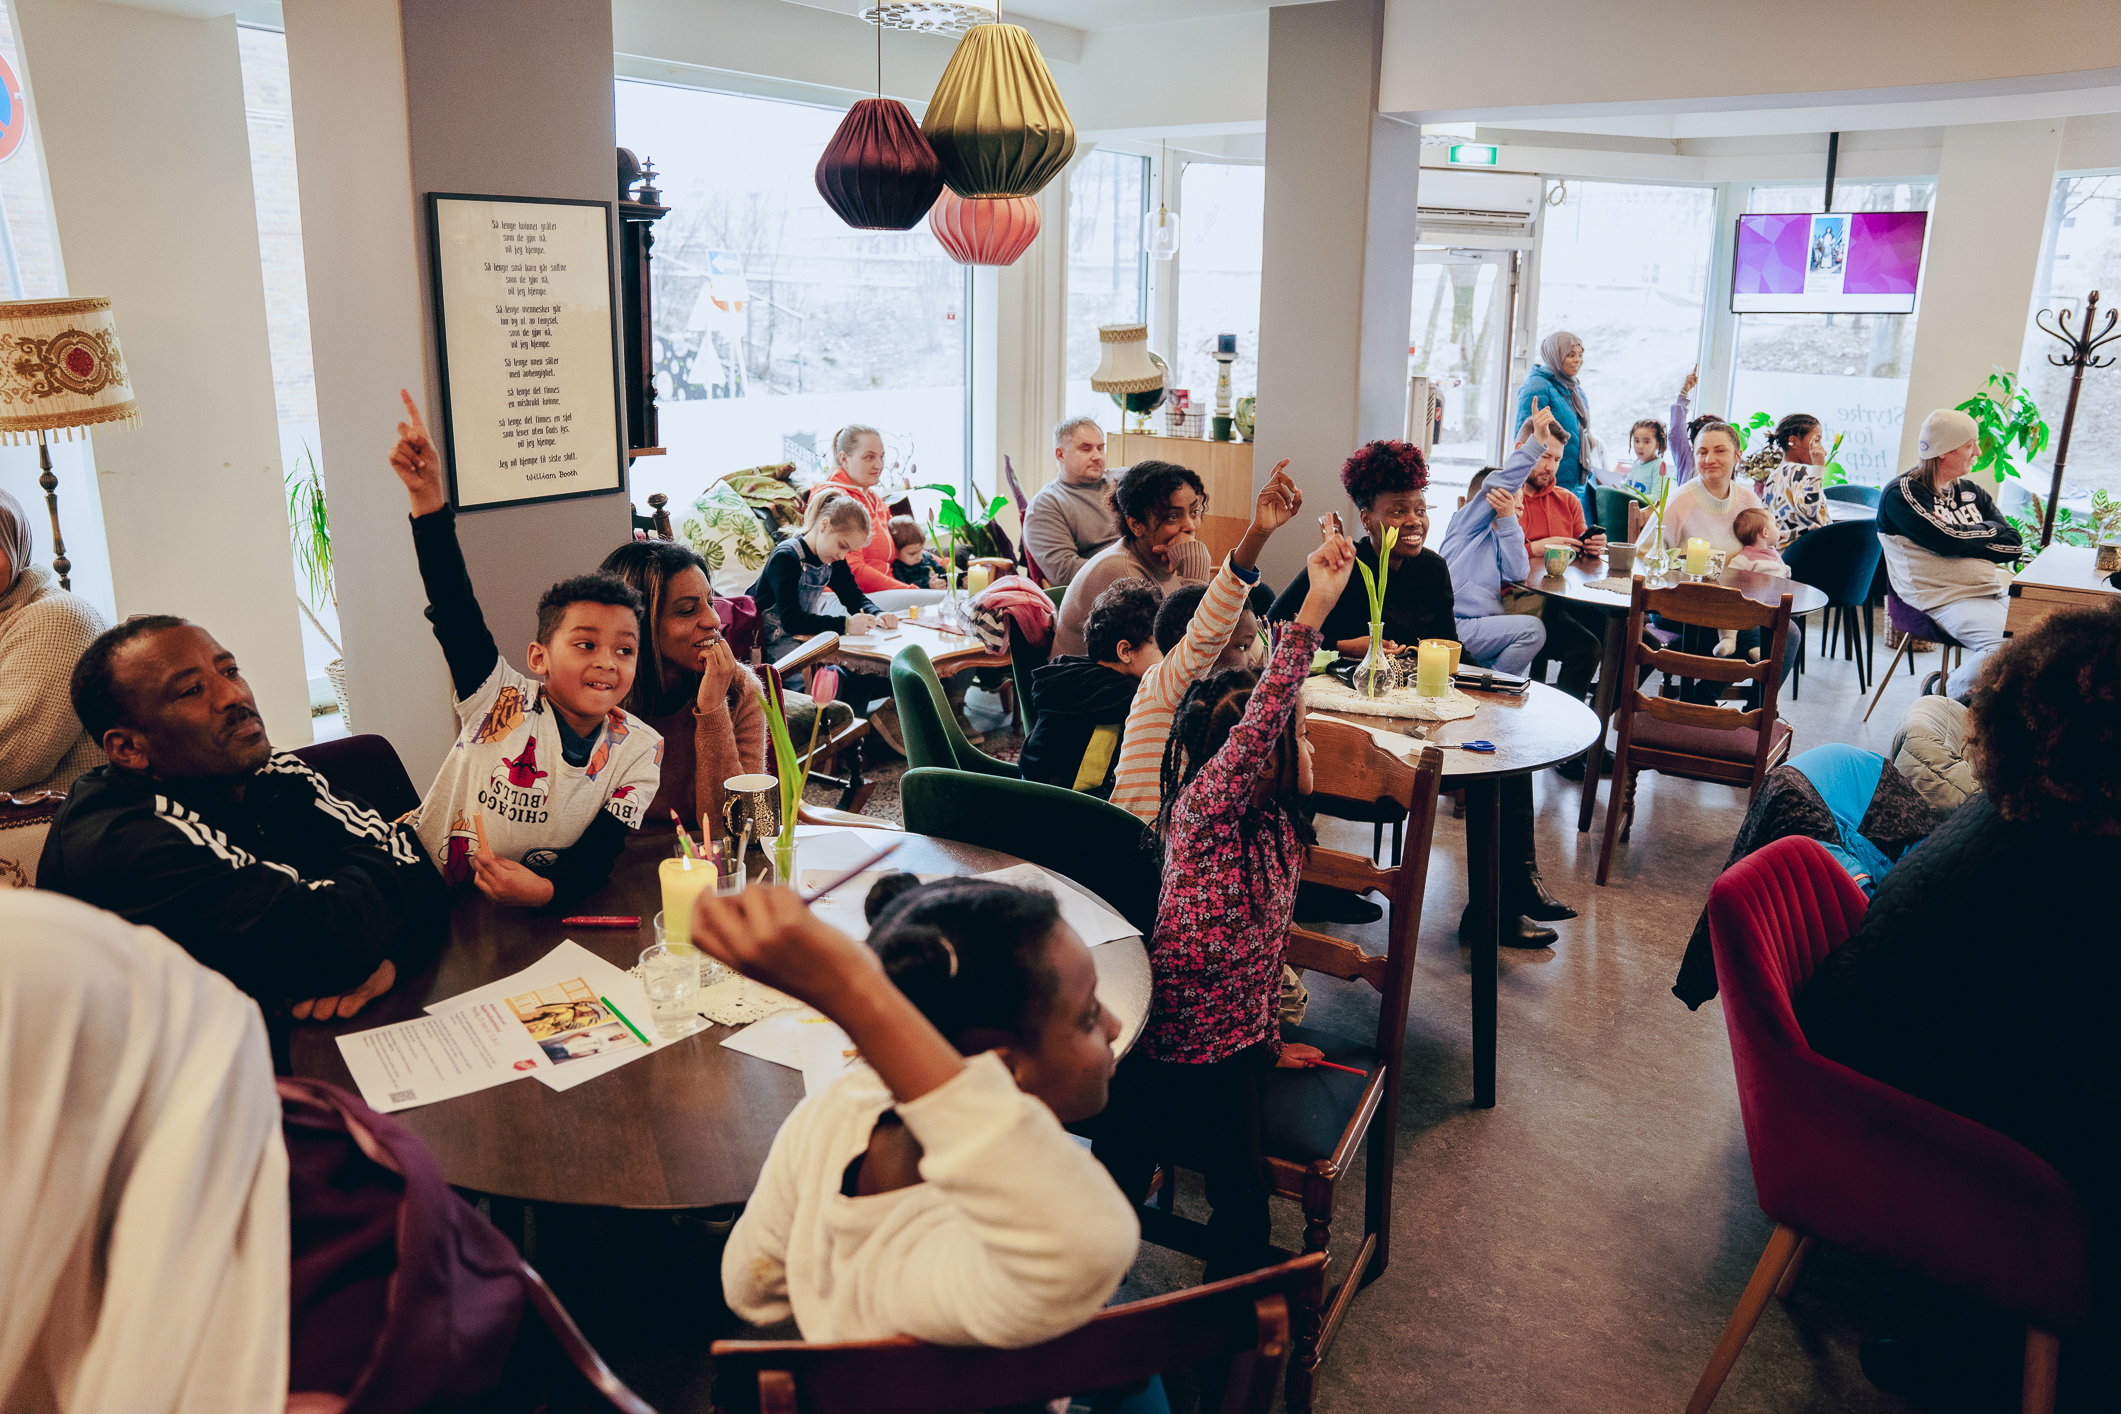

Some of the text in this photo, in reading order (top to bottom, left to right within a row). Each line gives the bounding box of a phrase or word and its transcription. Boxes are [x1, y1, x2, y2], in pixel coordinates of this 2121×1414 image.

[501, 220, 516, 232] lenge
[514, 245, 523, 255] jeg
[494, 263, 508, 273] lenge
[517, 287, 526, 297] jeg
[505, 305, 519, 315] lenge
[520, 340, 529, 350] jeg
[513, 358, 528, 368] lenge
[516, 387, 530, 397] lenge
[507, 418, 522, 427] lenge
[526, 439, 535, 449] jeg
[526, 470, 578, 482] William Booth
[493, 780, 542, 808] BULLS
[478, 790, 548, 824] CHICAGO
